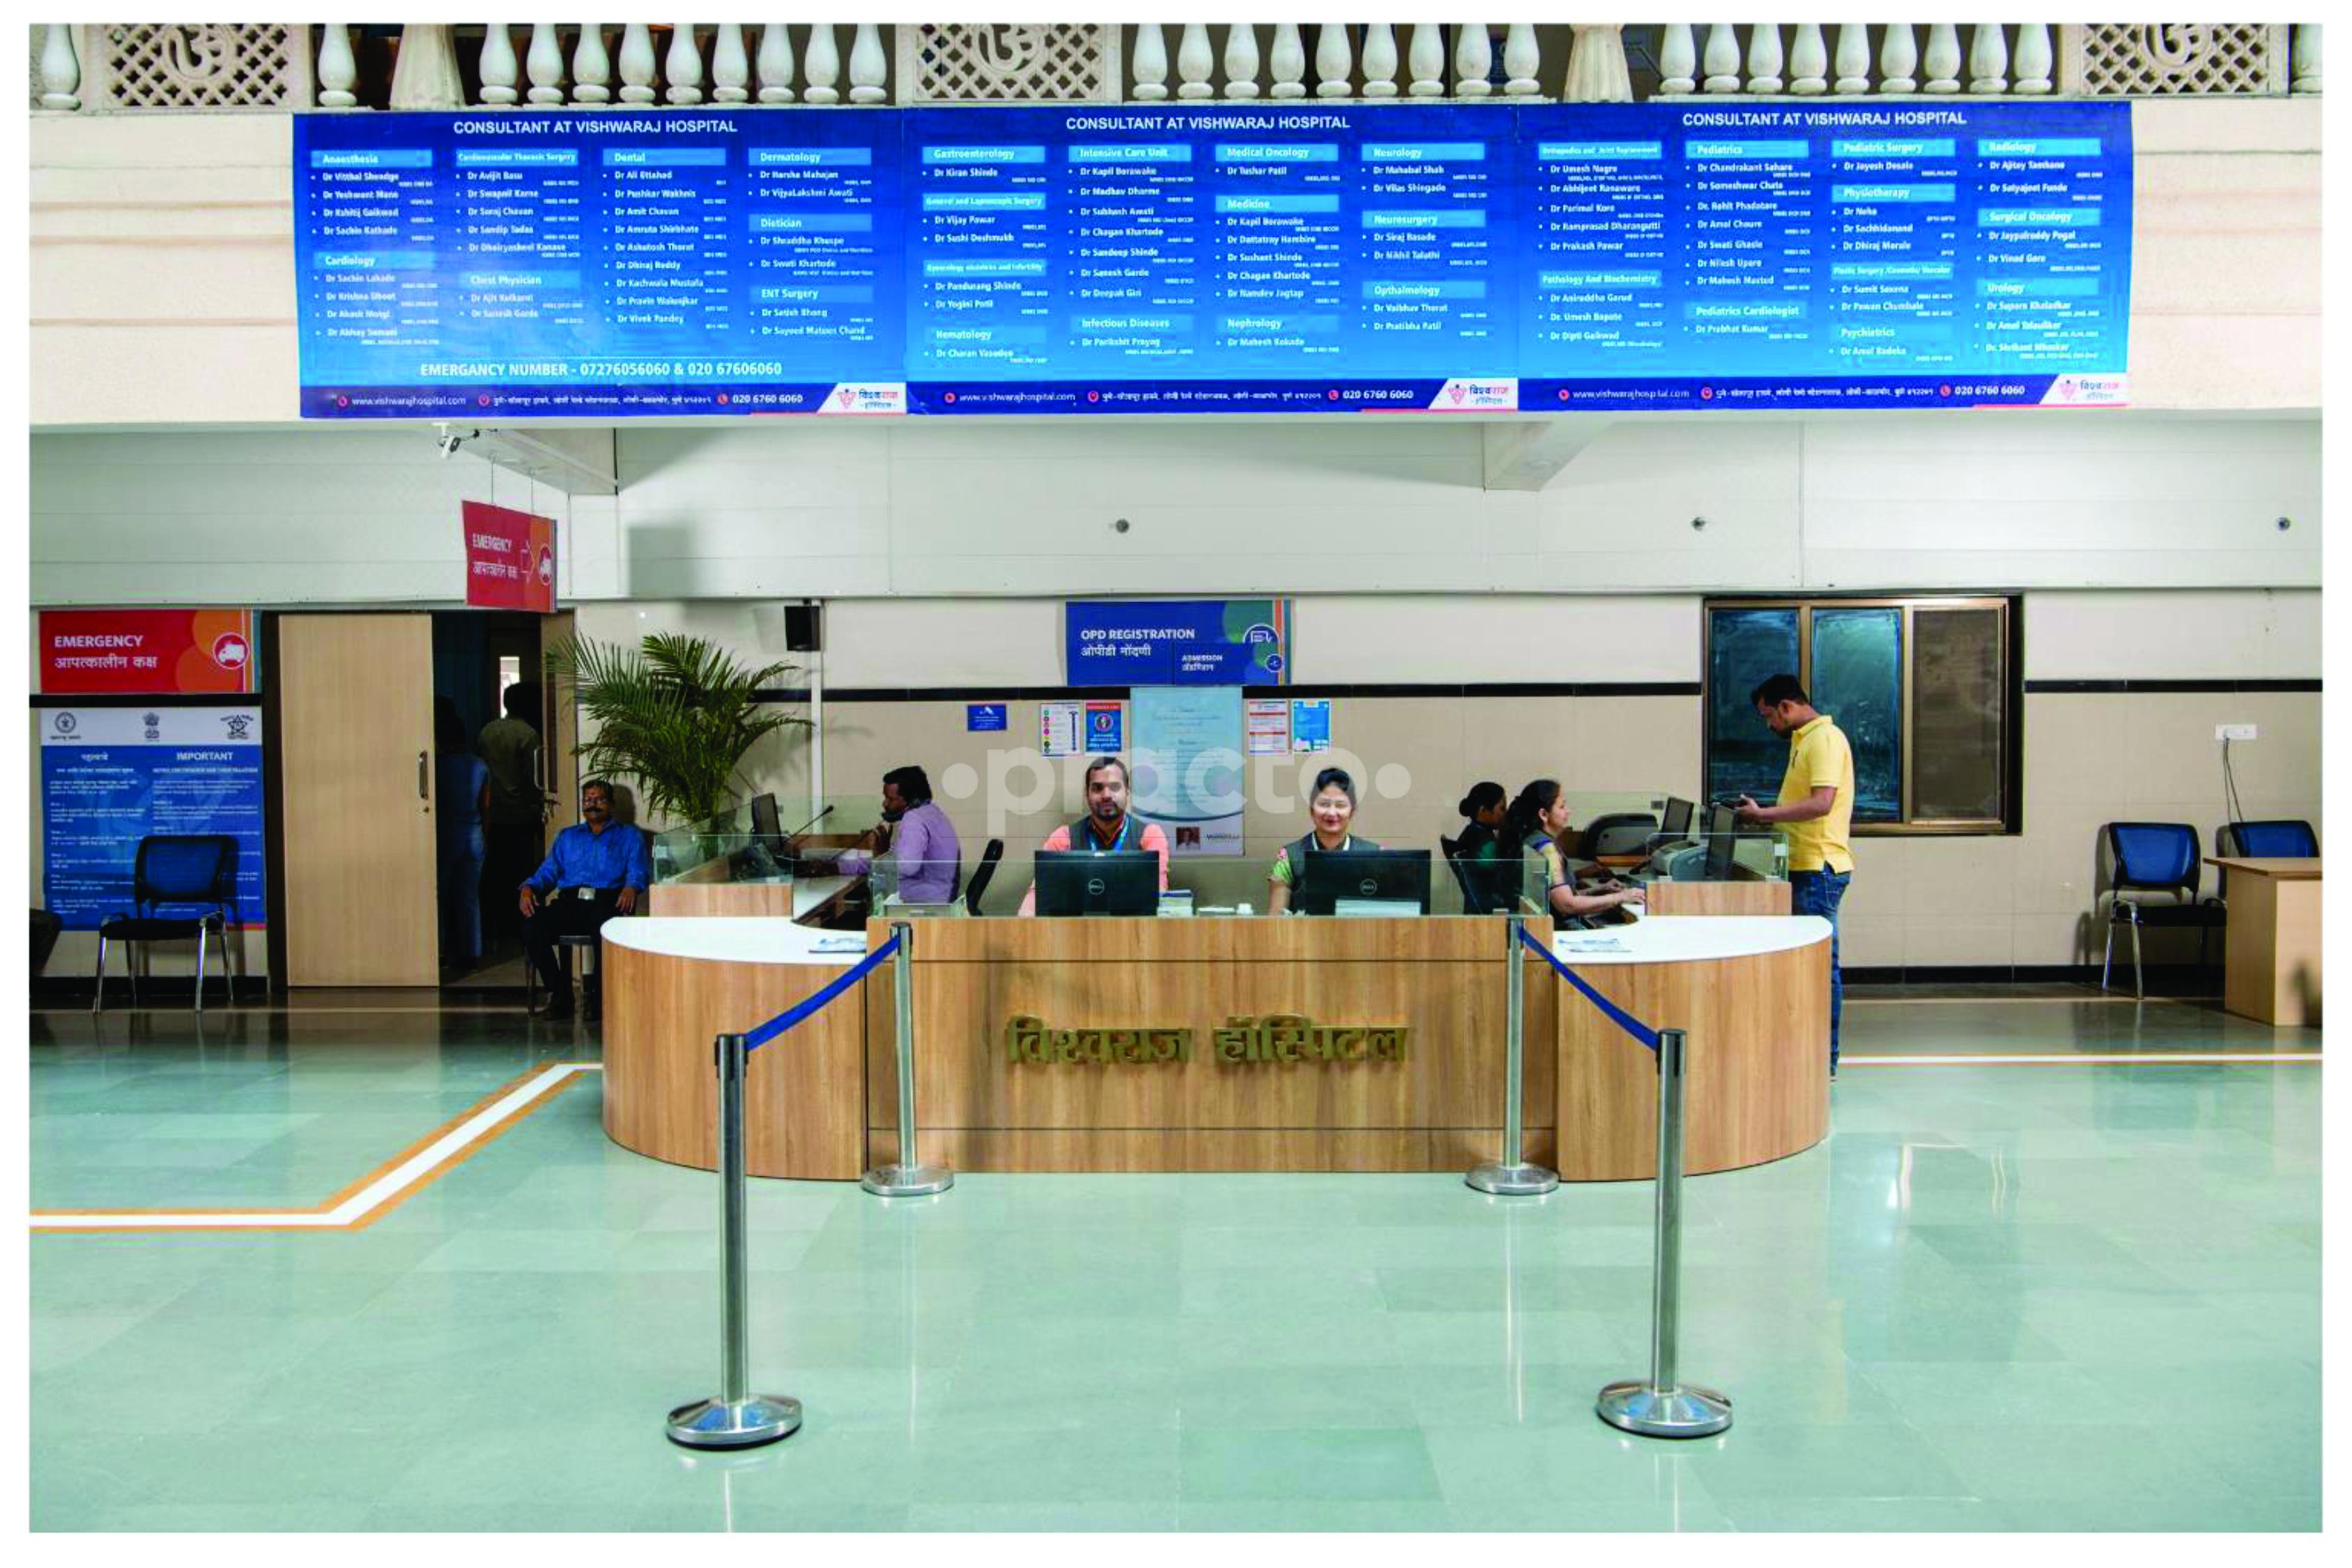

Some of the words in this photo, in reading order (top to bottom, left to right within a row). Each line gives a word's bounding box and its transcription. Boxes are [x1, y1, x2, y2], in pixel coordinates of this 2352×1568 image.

[1066, 117, 1163, 130] CONSULTANT
[1167, 117, 1185, 129] AT
[1188, 116, 1273, 129] VISHWARAJ
[1279, 116, 1351, 129] HOSPITAL
[1683, 112, 1780, 125] CONSULTANT
[1783, 113, 1802, 125] AT
[1805, 112, 1890, 125] VISHWARAJ
[1895, 112, 1967, 124] HOSPITAL
[454, 121, 550, 134] CONSULTANT
[554, 121, 572, 133] AT
[575, 121, 661, 133] VISHWARAJ
[666, 120, 737, 132] HOSPITAL
[1080, 148, 1122, 157] Intensive
[1125, 148, 1146, 157] Care
[1148, 148, 1168, 157] Unit
[1227, 147, 1263, 157] Medical
[1266, 147, 1309, 159] Oncology
[1373, 147, 1422, 159] Neurology
[1698, 145, 1743, 154] Pediatrics
[1843, 142, 1884, 153] Pediatric
[1886, 142, 1923, 154] Surgery
[1989, 141, 2036, 155] Radiology
[546, 153, 576, 162] Surgery
[615, 153, 645, 162] Dental
[760, 153, 821, 164] Dermatology
[934, 149, 1015, 160] Gastroenterology
[970, 167, 999, 176] Shinde
[1092, 167, 1114, 177] Kapil
[1227, 167, 1237, 175] Dr
[1268, 167, 1286, 175] Patil
[1424, 165, 1444, 174] Shah
[1698, 163, 1707, 172] Dr
[1844, 162, 1854, 171] Dr
[468, 171, 477, 180] Dr
[615, 171, 624, 179] Dr
[803, 170, 838, 180] Mahajan
[1843, 187, 1910, 199] Physiotherapy
[1990, 183, 2000, 192] Dr
[468, 190, 477, 198] Dr
[1227, 199, 1270, 209] Medicine
[935, 215, 944, 224] Dr
[946, 215, 967, 226] Vijay
[1374, 215, 1438, 226] Neurosurgery
[1990, 211, 2027, 223] Surgical
[2029, 210, 2073, 223] Oncology
[1597, 241, 1624, 250] Pawar
[1130, 248, 1158, 256] Shinde
[325, 255, 375, 267] Cardiology
[498, 275, 541, 286] Physician
[1604, 274, 1657, 286] Biochemistry
[761, 289, 780, 298] ENT
[782, 289, 818, 300] Surgery
[1374, 285, 1440, 297] Opthalmology
[1988, 283, 2025, 295] Urology
[1743, 305, 1799, 317] Cardiologist
[1082, 318, 1127, 328] Infectious
[1130, 318, 1170, 328] Diseases
[1228, 318, 1282, 330] Nephrology
[936, 329, 992, 340] Hematology
[420, 363, 505, 376] EMERGANCY
[509, 363, 568, 376] NUMBER
[580, 362, 670, 376] 07276056060
[673, 363, 683, 376] &
[687, 362, 713, 375] 020
[716, 362, 782, 375] 67606060
[1343, 390, 1360, 399] 020
[1363, 390, 1388, 399] 6760
[1390, 390, 1415, 399] 6060
[1955, 385, 1972, 395] 020
[1974, 385, 1999, 395] 6760
[2001, 385, 2025, 395] 6060
[732, 394, 750, 403] 020
[752, 394, 776, 403] 6760
[778, 394, 804, 403] 6060
[1081, 629, 1106, 640] OPD
[1109, 629, 1195, 640] REGISTRATION
[54, 634, 144, 649] EMERGENCY
[133, 655, 157, 669] कक्ष
[176, 751, 233, 760] IMPORTANT
